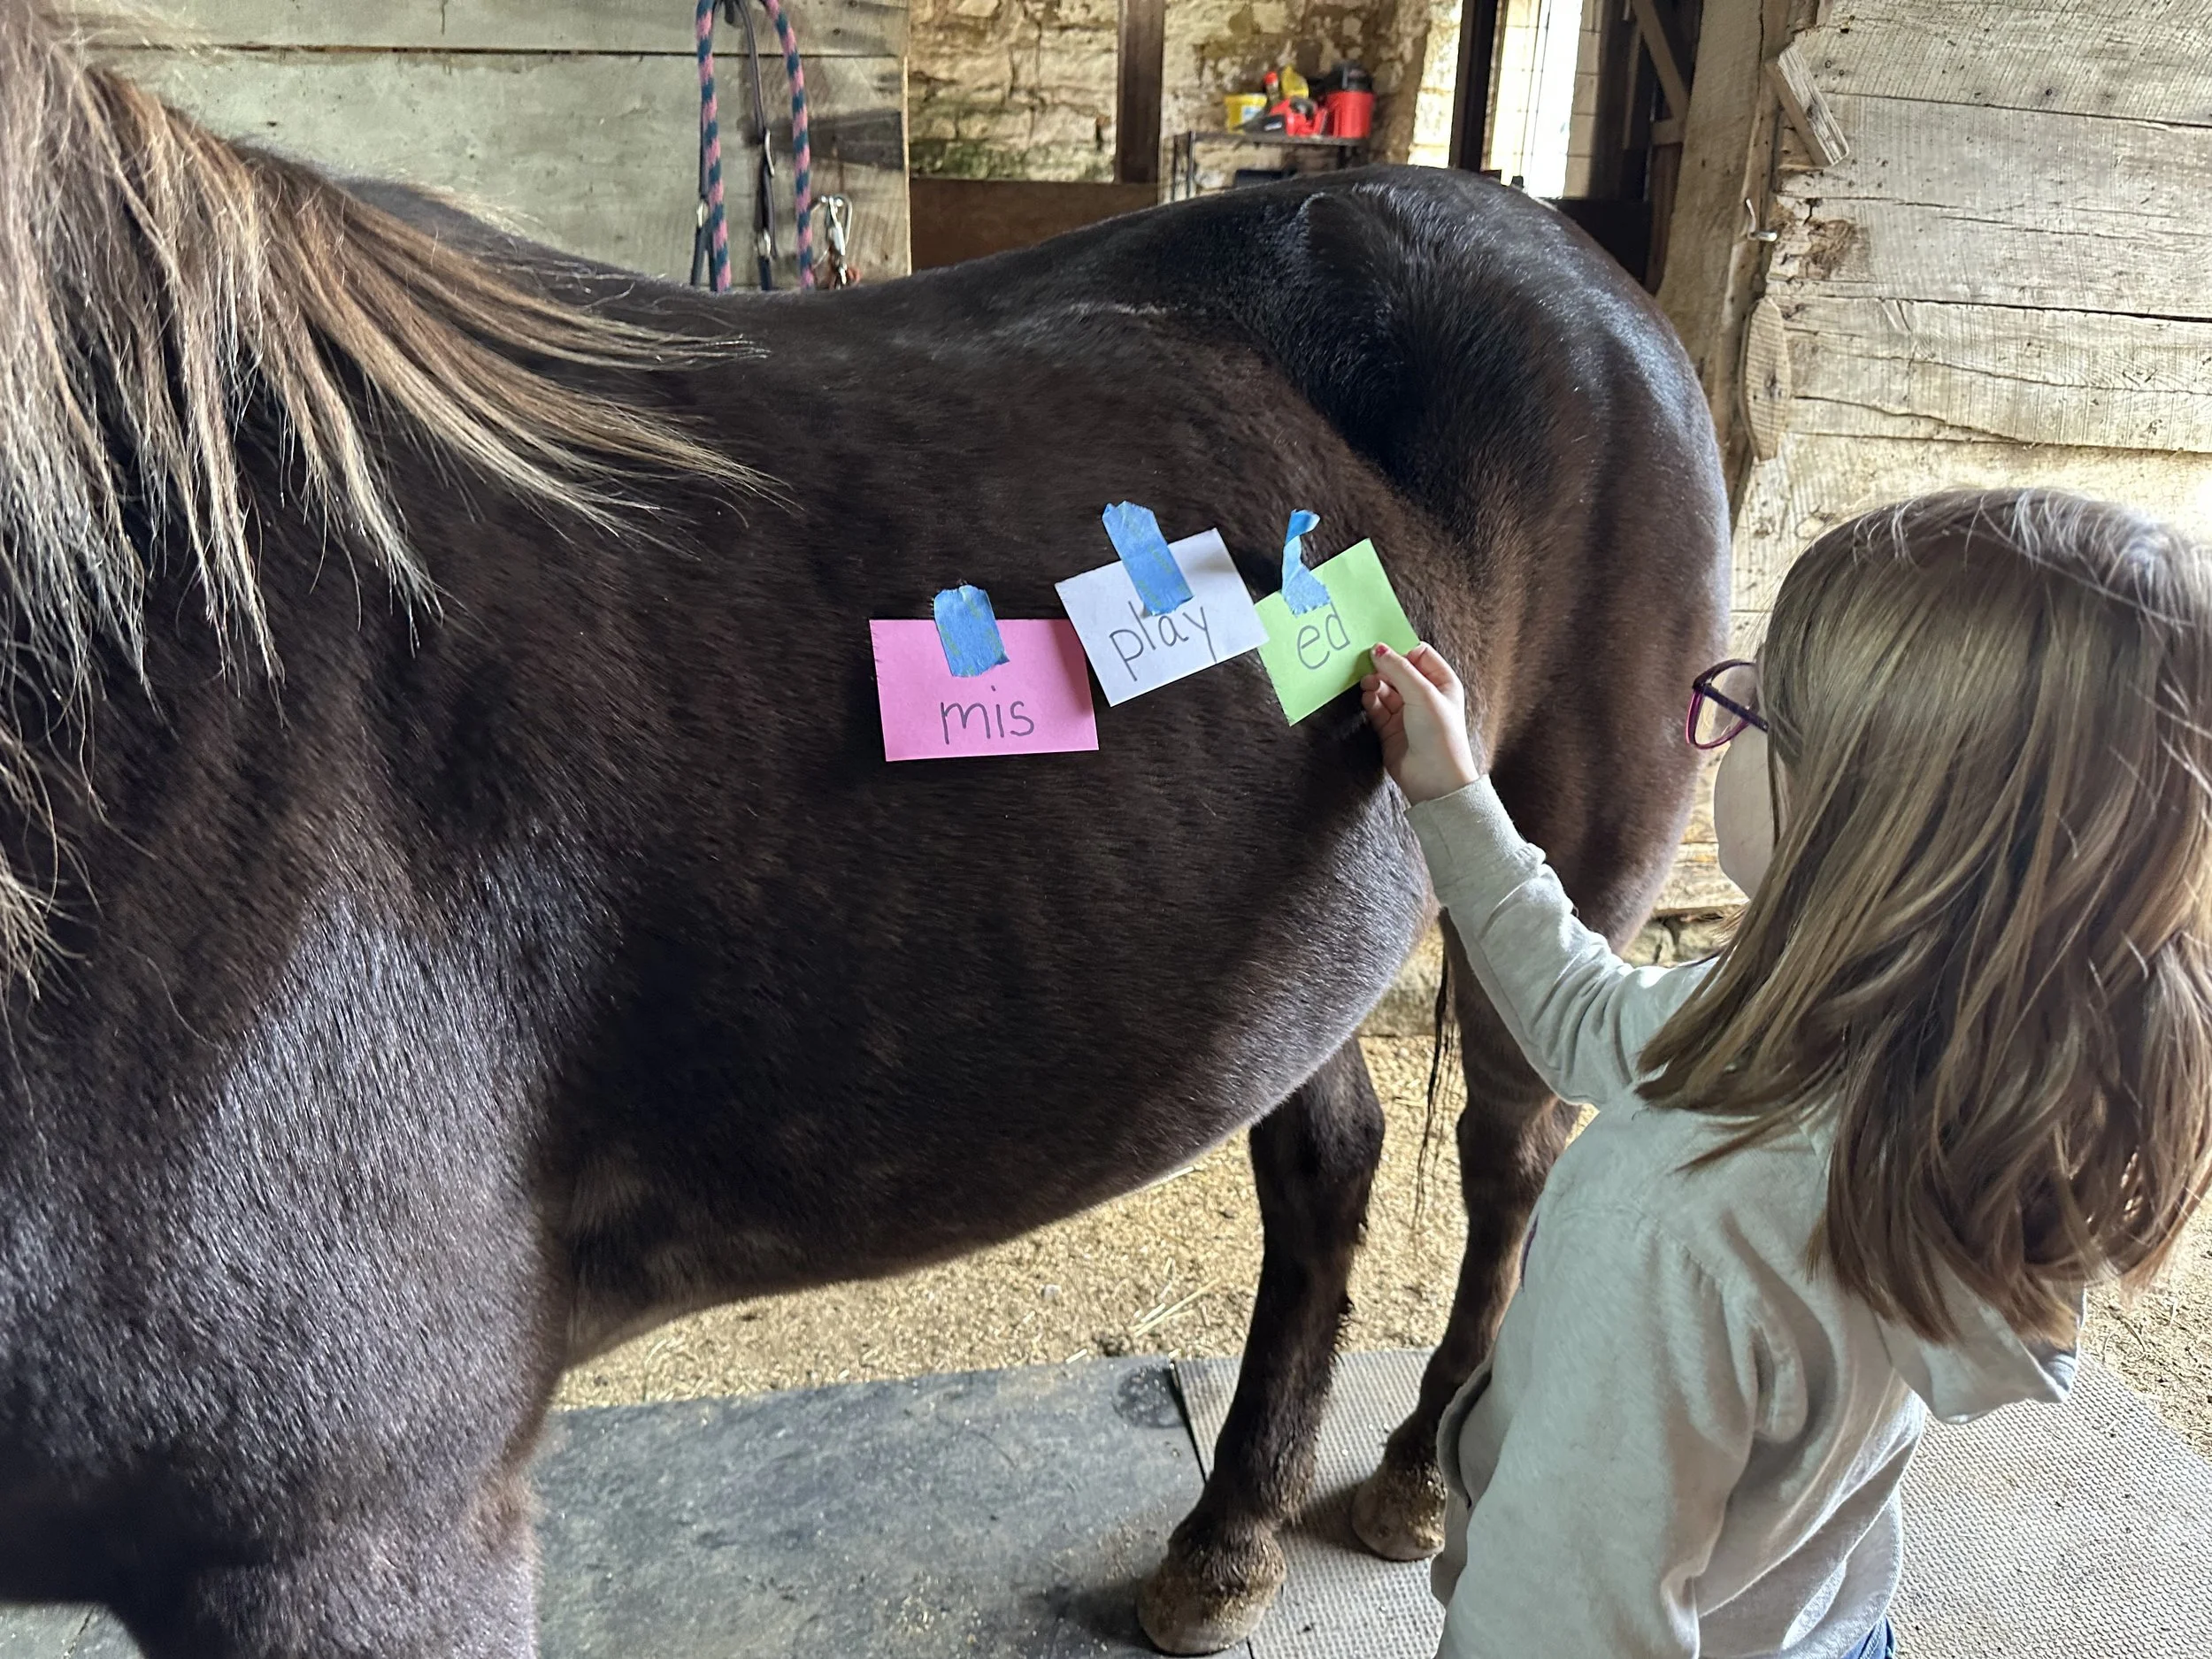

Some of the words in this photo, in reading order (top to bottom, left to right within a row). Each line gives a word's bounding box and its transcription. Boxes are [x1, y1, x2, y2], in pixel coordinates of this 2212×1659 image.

[1110, 601, 1217, 682] play
[1297, 602, 1351, 670] ed
[941, 686, 1034, 745] mis
